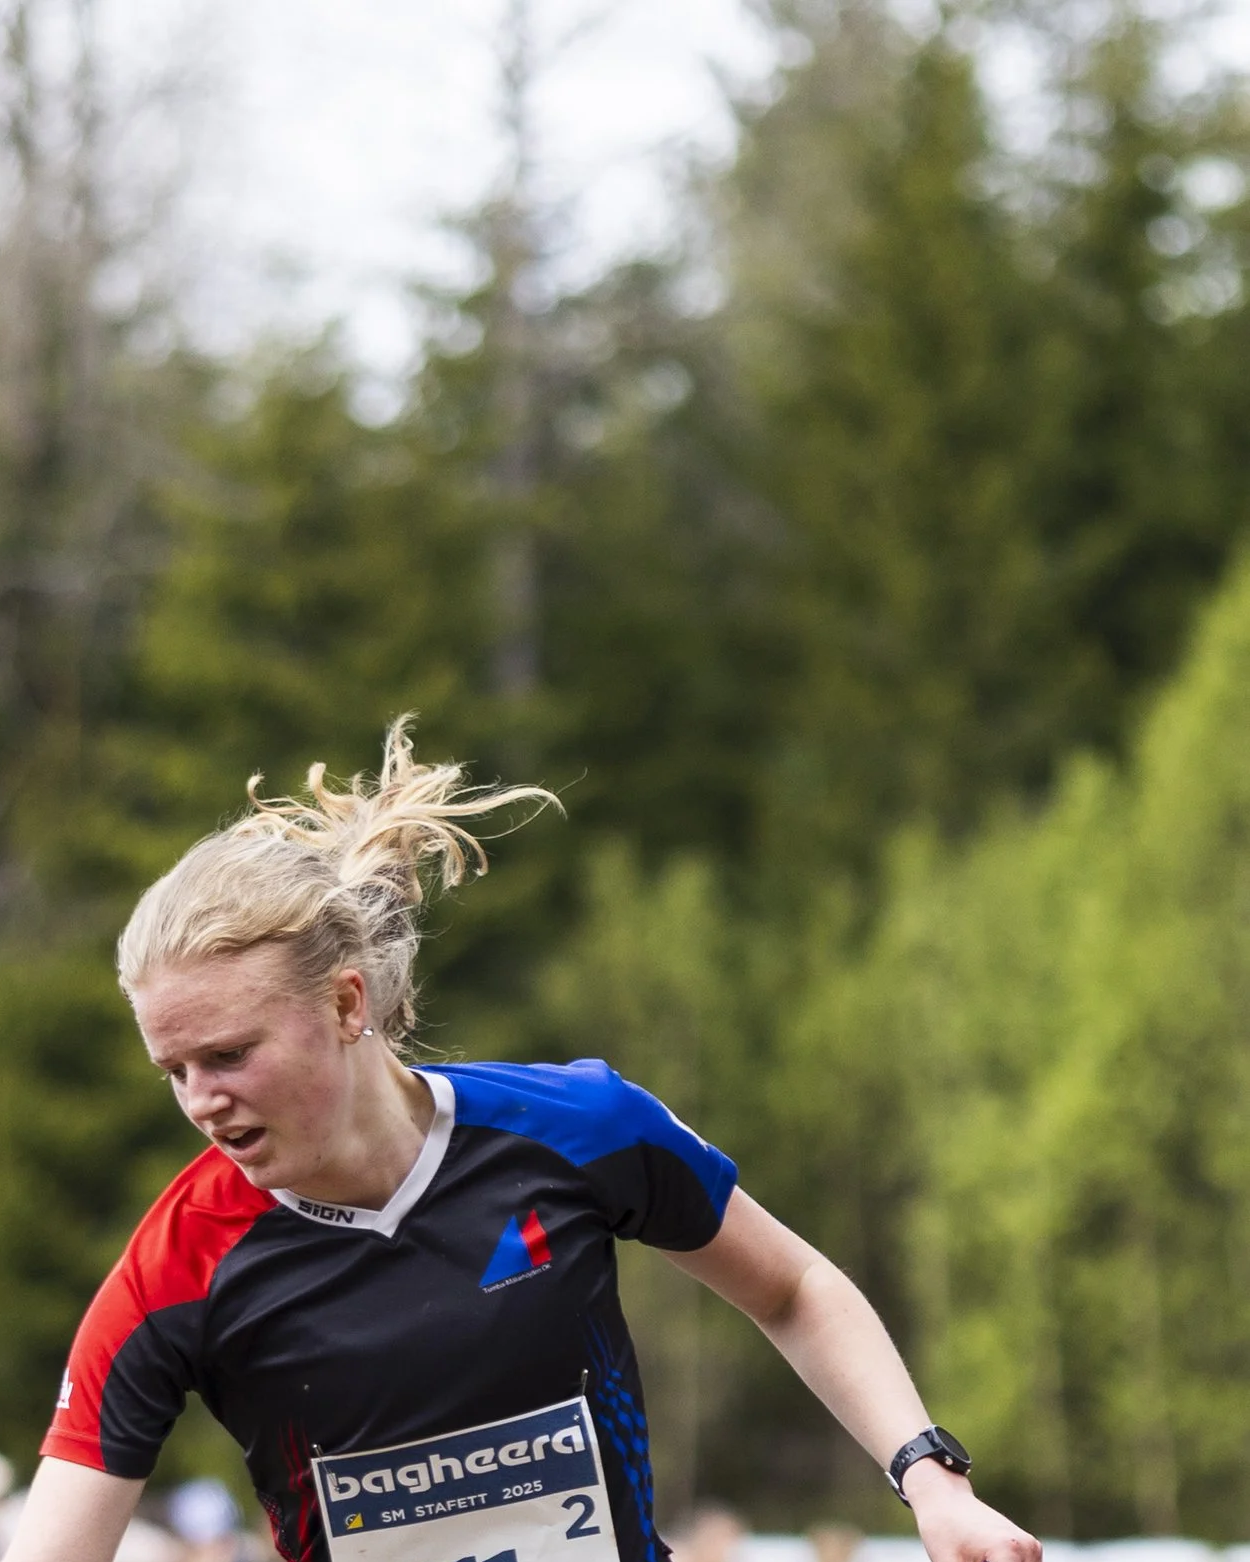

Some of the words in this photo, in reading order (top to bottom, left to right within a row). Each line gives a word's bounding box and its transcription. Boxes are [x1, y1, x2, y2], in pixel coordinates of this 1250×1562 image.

[327, 1425, 586, 1501] bagheera
[381, 1508, 406, 1524] SM
[415, 1493, 488, 1517] STAFETT
[502, 1480, 544, 1500] 2025
[561, 1494, 601, 1540] 2
